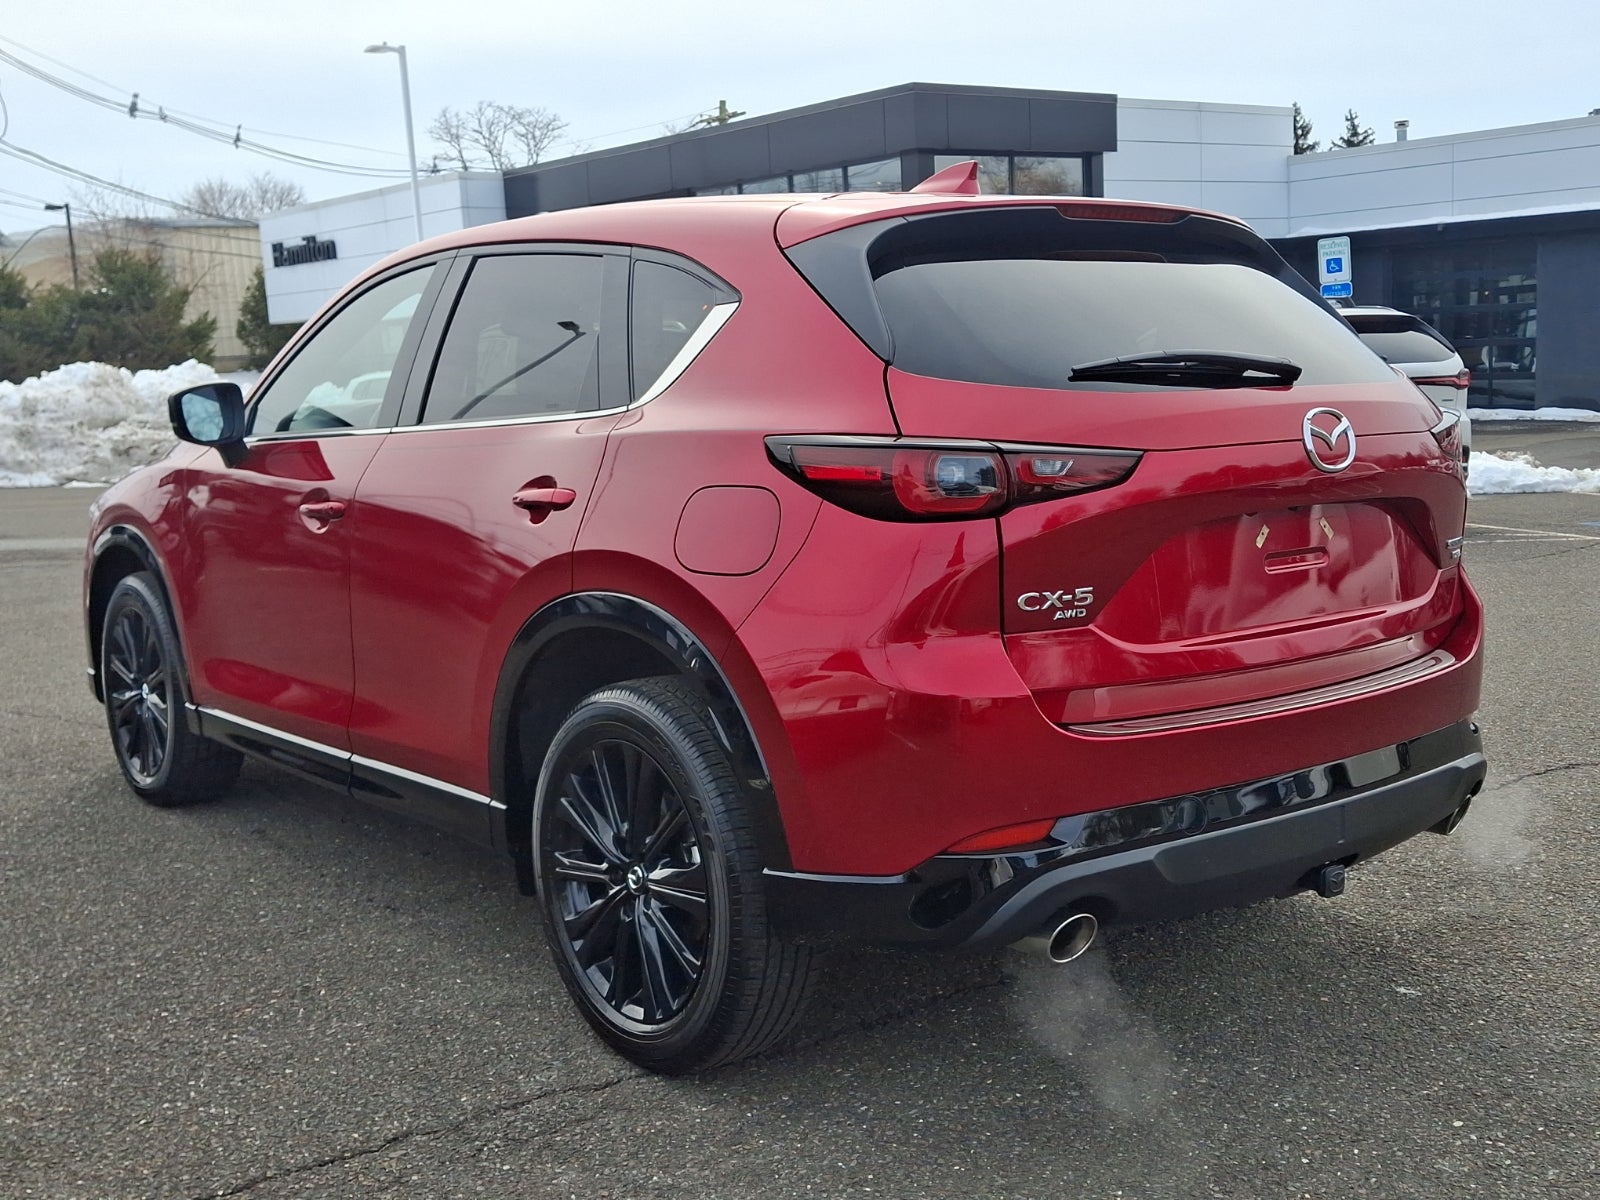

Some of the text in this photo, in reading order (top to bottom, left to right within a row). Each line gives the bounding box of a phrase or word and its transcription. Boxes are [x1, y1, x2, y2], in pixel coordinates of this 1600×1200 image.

[272, 235, 337, 267] Hamilton
[1017, 587, 1094, 611] CX-5
[1053, 608, 1087, 620] AWD
